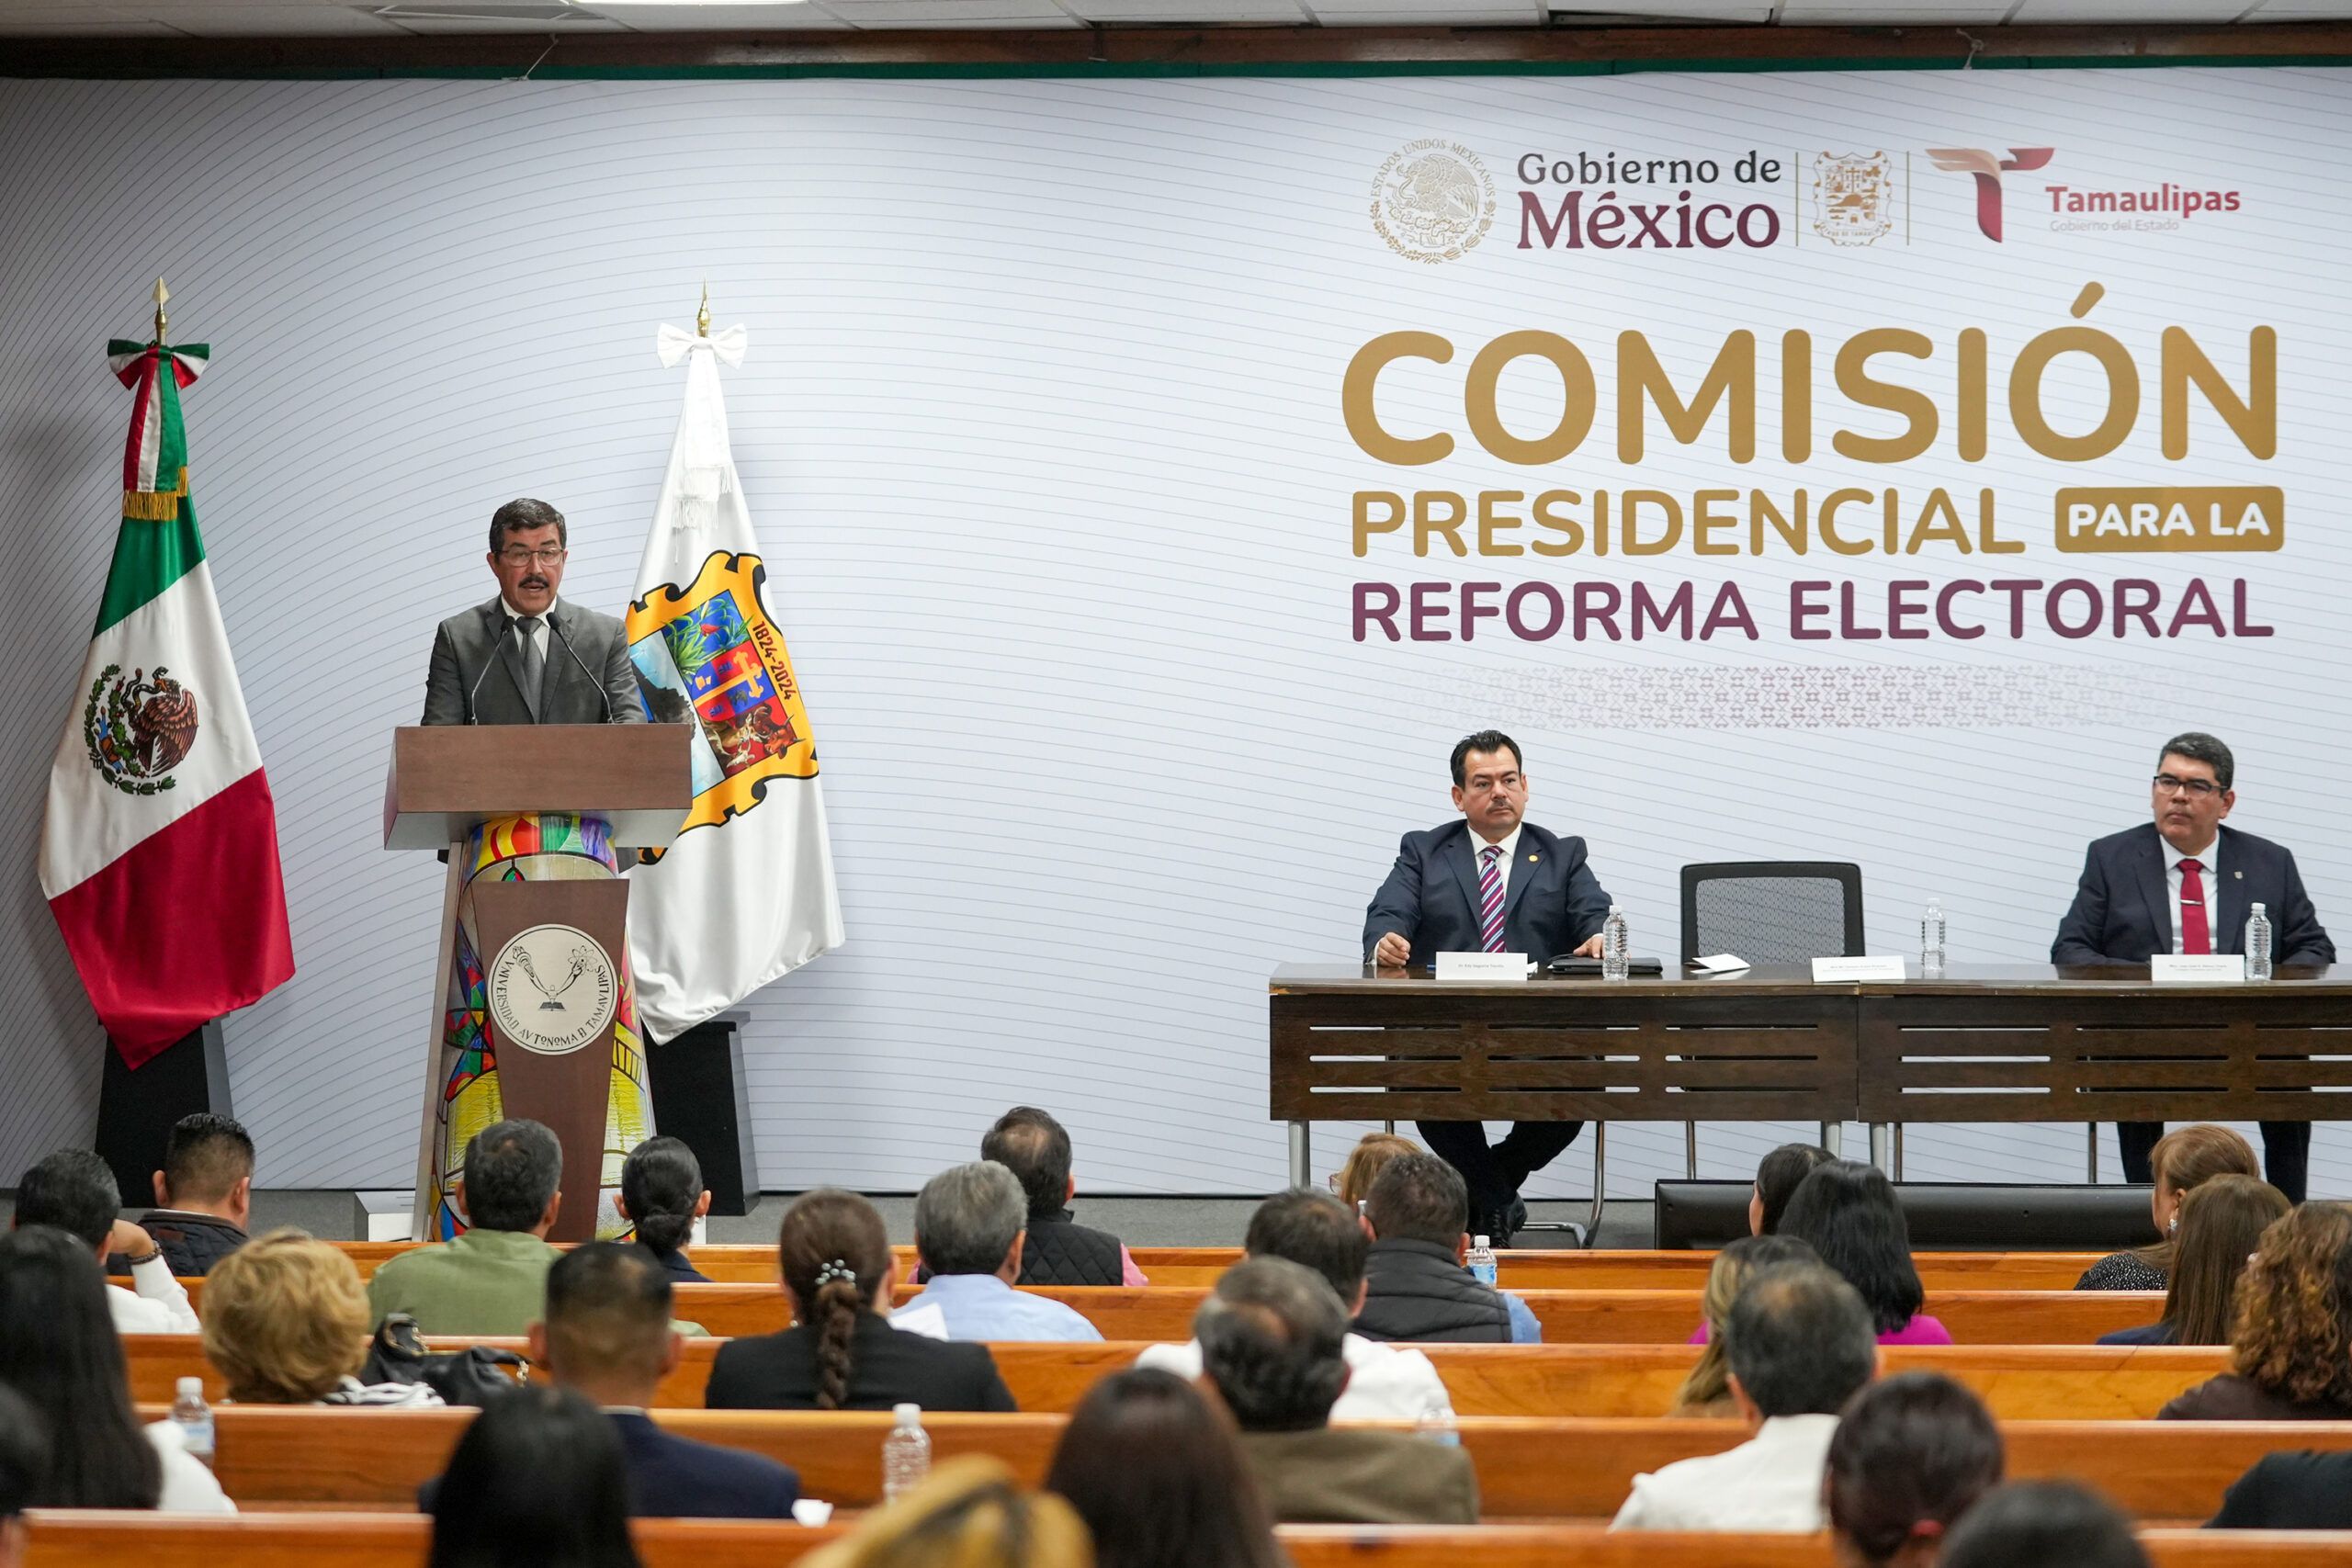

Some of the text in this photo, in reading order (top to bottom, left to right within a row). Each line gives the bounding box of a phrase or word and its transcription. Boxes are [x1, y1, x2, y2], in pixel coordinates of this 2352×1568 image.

[1371, 138, 1496, 197] ESTADOS UNIDOS MEXICANOS
[1517, 150, 1781, 186] Gobierno de
[1517, 189, 1781, 249] México
[2045, 183, 2241, 219] Tamaulipas
[2050, 219, 2180, 231] Gobierno del Estado
[1341, 281, 2278, 467] COMISIÓN
[1351, 487, 2270, 558] PRESIDENCIAL PARA LA
[1351, 577, 2275, 643] REFORMA ELECTORAL
[752, 621, 797, 700] 1824-2024
